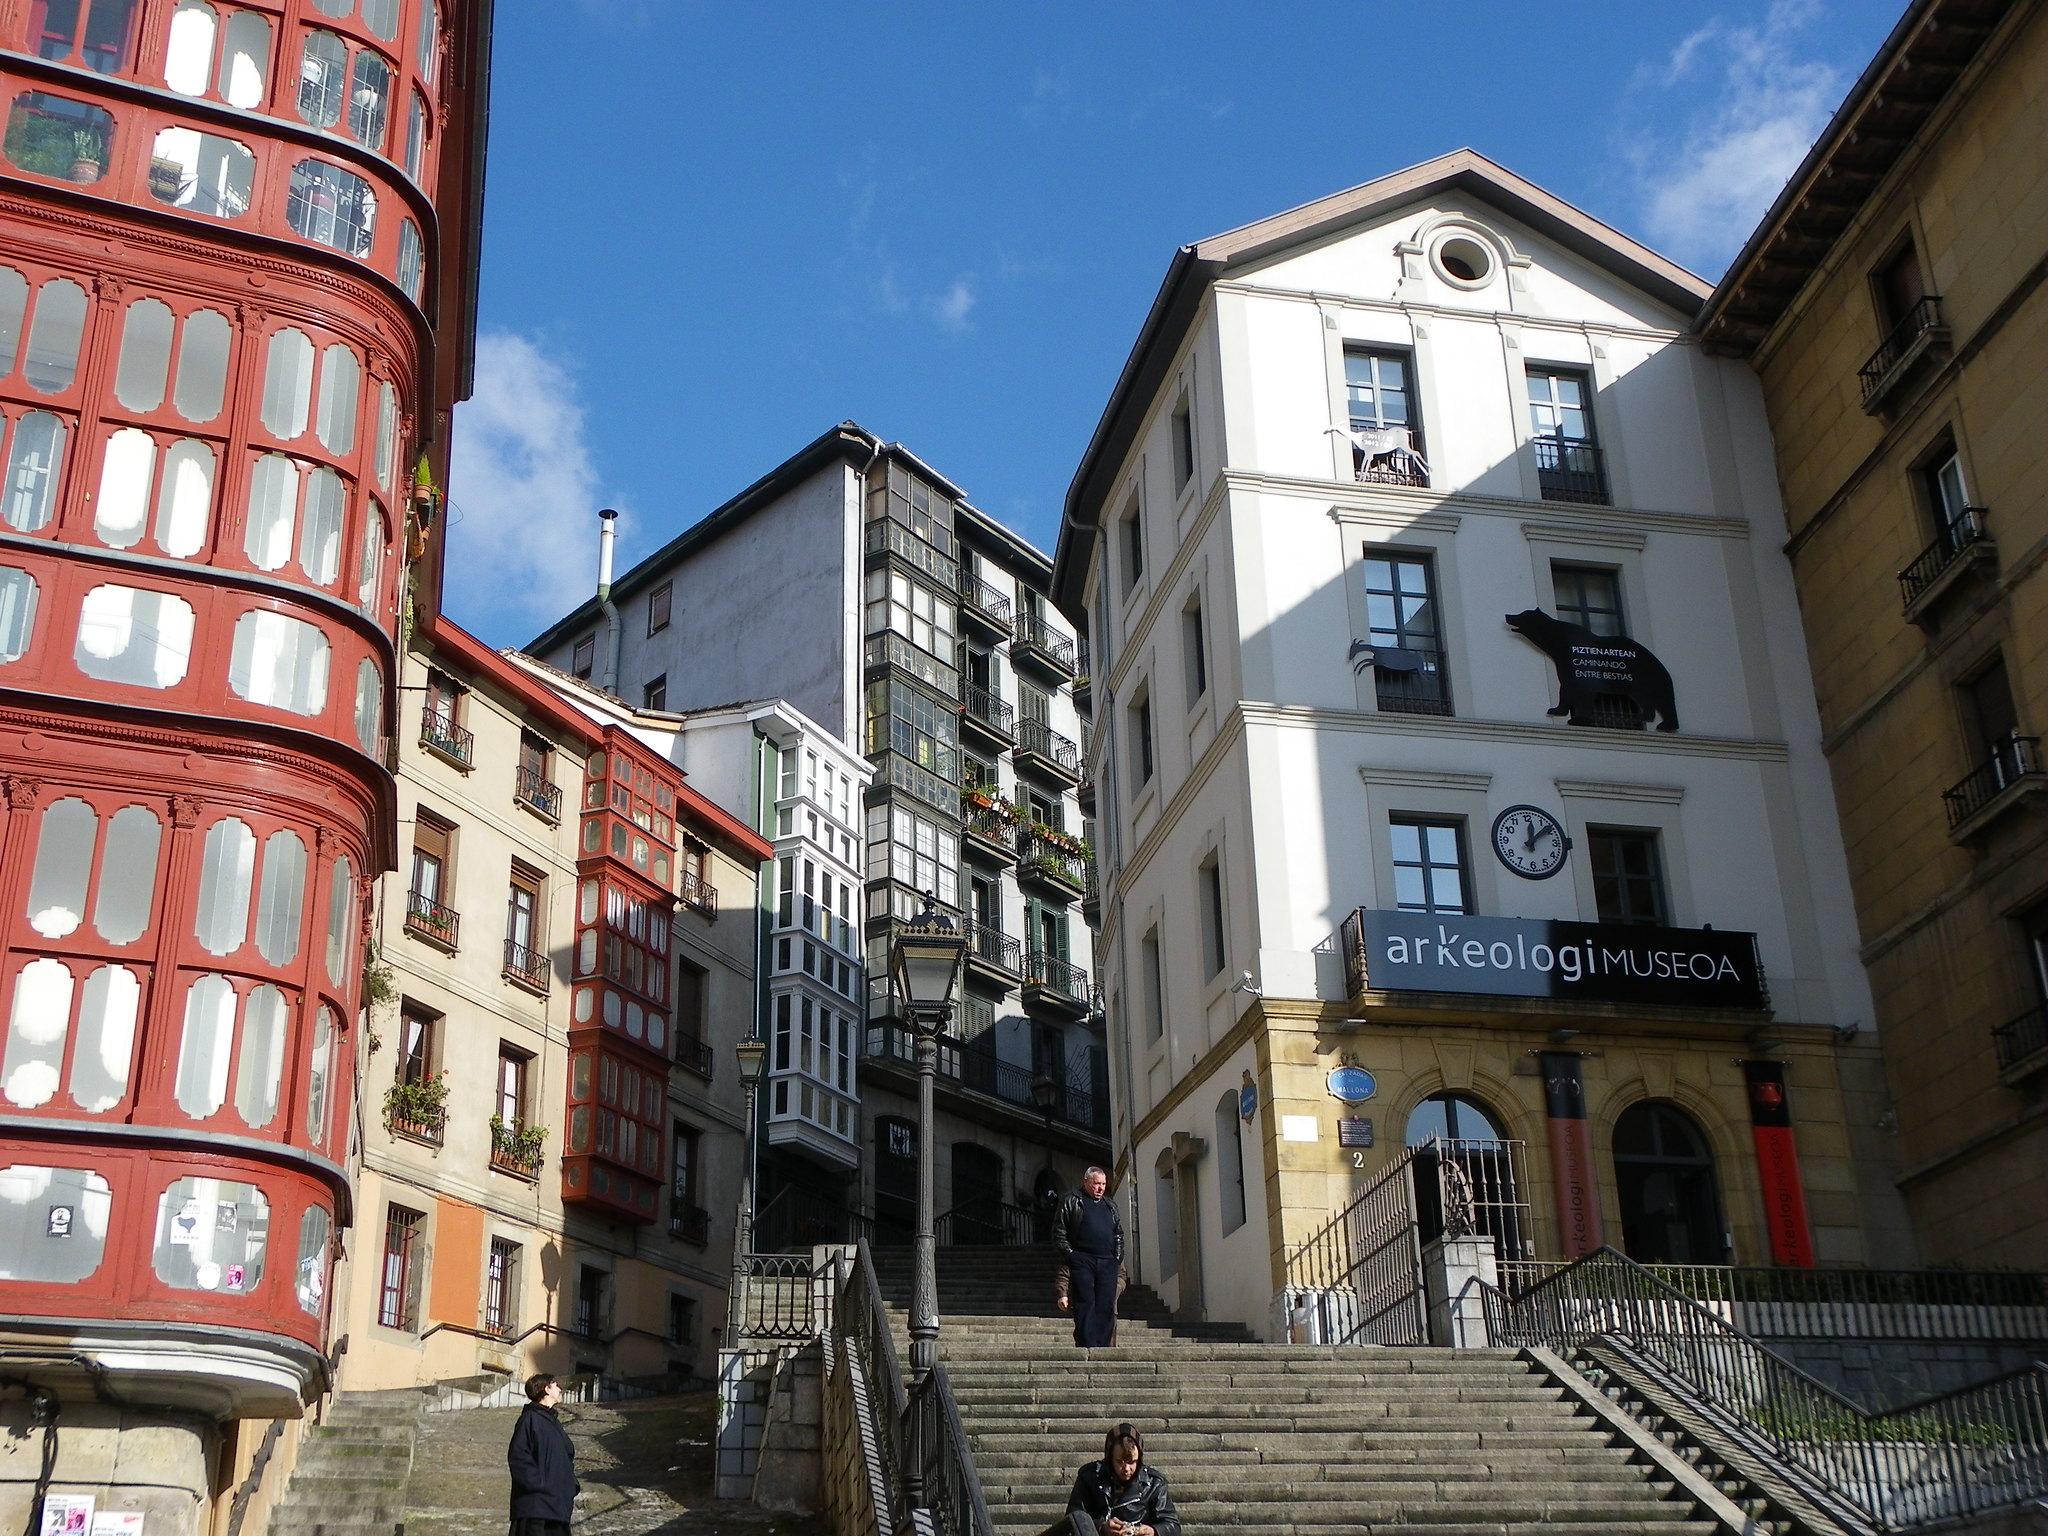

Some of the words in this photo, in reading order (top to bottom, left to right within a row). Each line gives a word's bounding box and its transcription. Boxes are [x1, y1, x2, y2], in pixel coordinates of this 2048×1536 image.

[1572, 658, 1627, 669] CAMINANDO
[1575, 670, 1601, 679] ENTRE
[1602, 671, 1633, 681] BESTIAS
[1511, 818, 1518, 826] 11
[1505, 826, 1514, 834] 10
[1503, 836, 1509, 844] 9
[1552, 839, 1558, 848] 3
[1508, 849, 1514, 857] 8
[1550, 851, 1556, 859] 4
[1518, 857, 1523, 865] 7
[1543, 859, 1548, 867] 5
[1530, 861, 1536, 870] 6
[1353, 1151, 1365, 1168] 2
